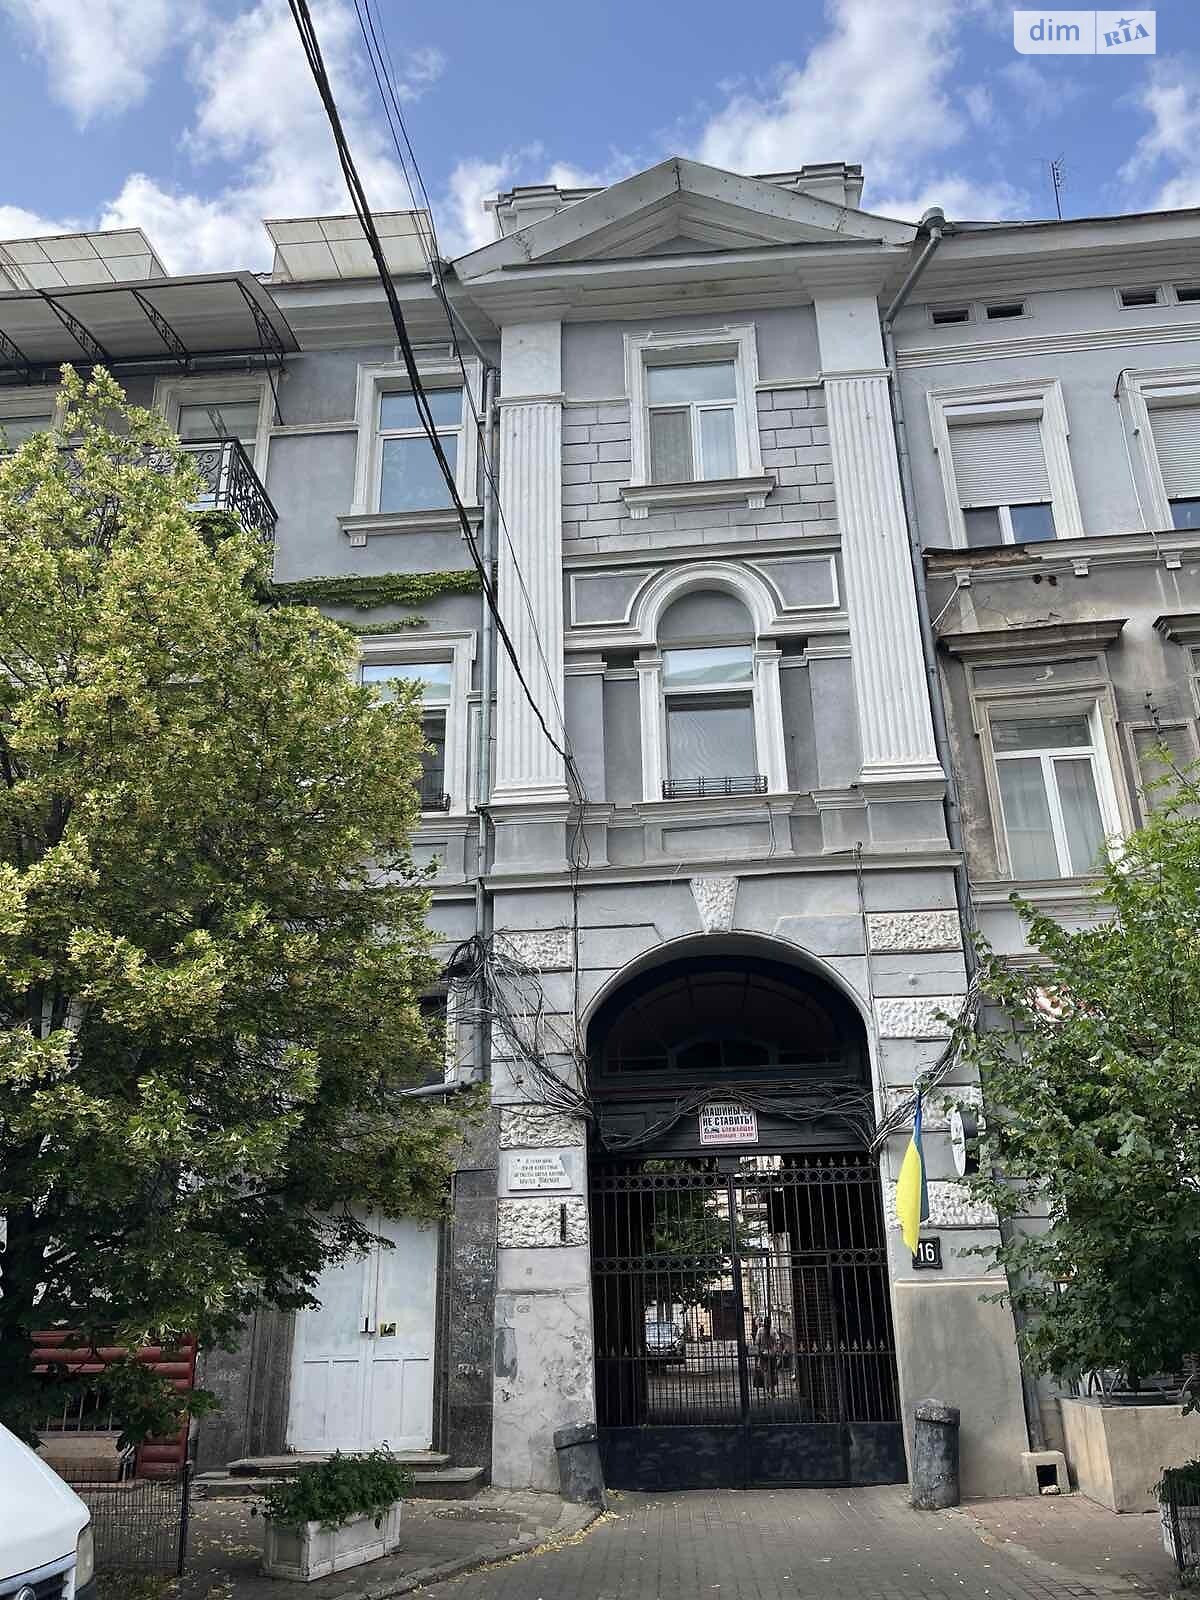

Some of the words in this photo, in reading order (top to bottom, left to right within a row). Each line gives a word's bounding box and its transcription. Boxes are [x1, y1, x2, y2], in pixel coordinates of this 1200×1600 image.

[703, 1104, 740, 1116] МАШИНЫ
[703, 1117, 712, 1126] НЕ
[715, 1115, 753, 1125] СТАВИТЬ!
[919, 1243, 934, 1261] 16
